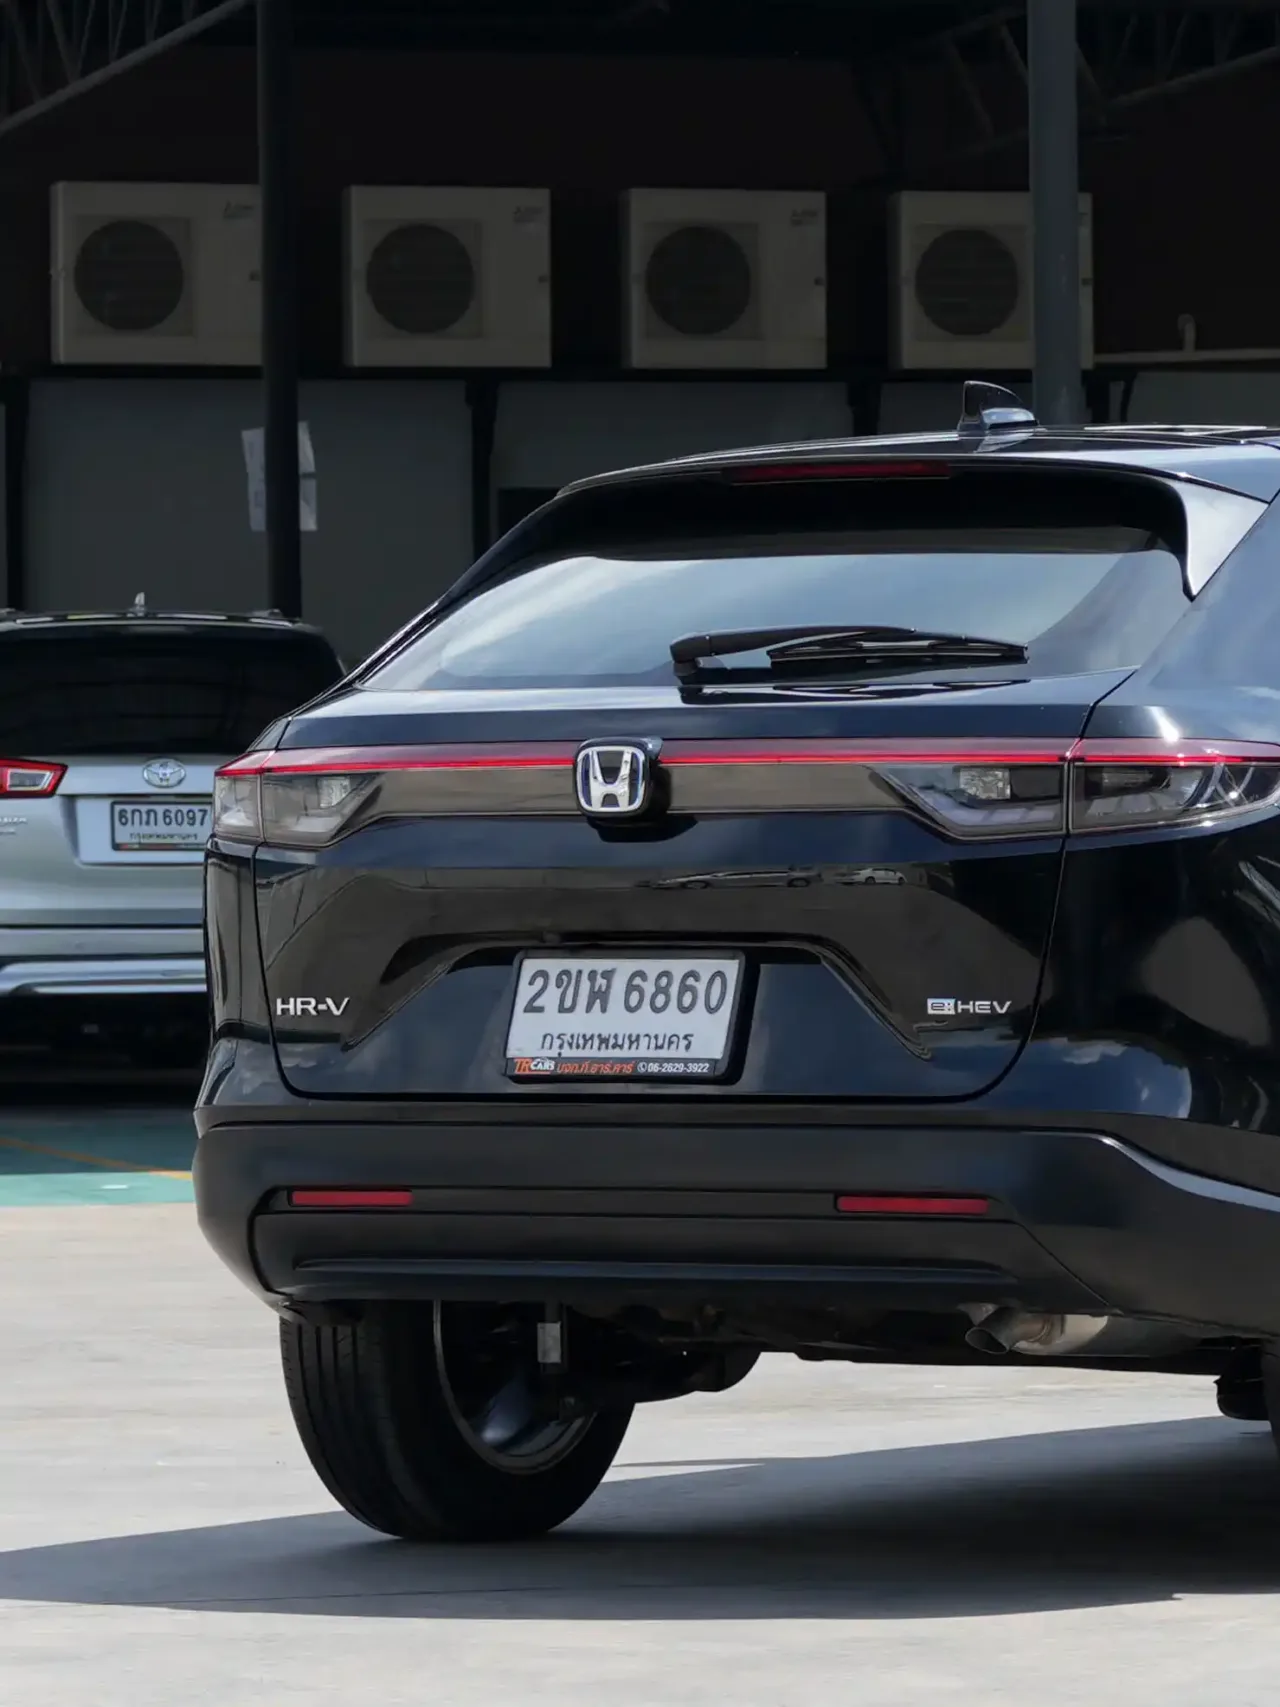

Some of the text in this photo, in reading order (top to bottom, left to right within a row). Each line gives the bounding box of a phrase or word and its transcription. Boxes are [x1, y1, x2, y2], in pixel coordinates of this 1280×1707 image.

[163, 808, 208, 827] 6097
[623, 969, 727, 1014] 6860
[276, 996, 350, 1016] HR-V
[541, 1032, 694, 1058] กรุงเทพมหานคร
